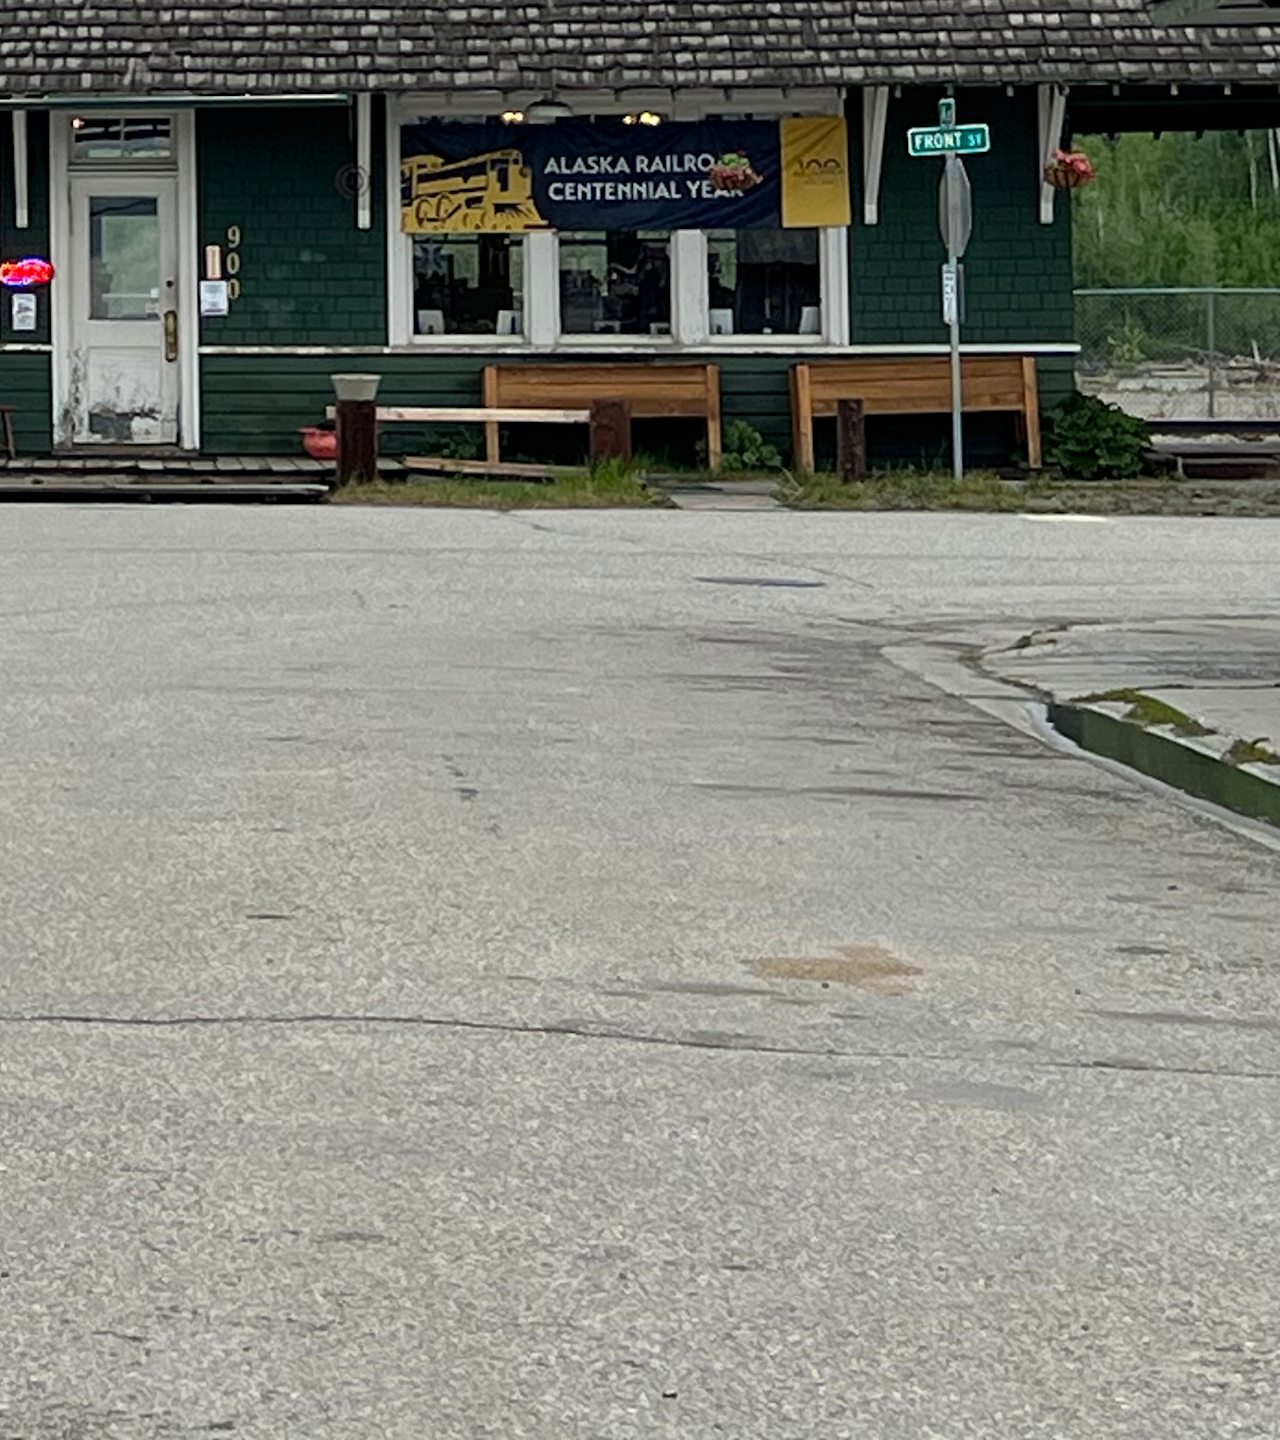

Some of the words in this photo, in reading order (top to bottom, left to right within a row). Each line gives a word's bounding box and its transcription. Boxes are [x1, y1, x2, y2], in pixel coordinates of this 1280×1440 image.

[915, 133, 961, 150] FRONT
[968, 133, 982, 146] ST
[544, 157, 630, 174] ALASKA
[636, 153, 715, 172] RAILRO
[548, 181, 682, 200] CENTENNIAL
